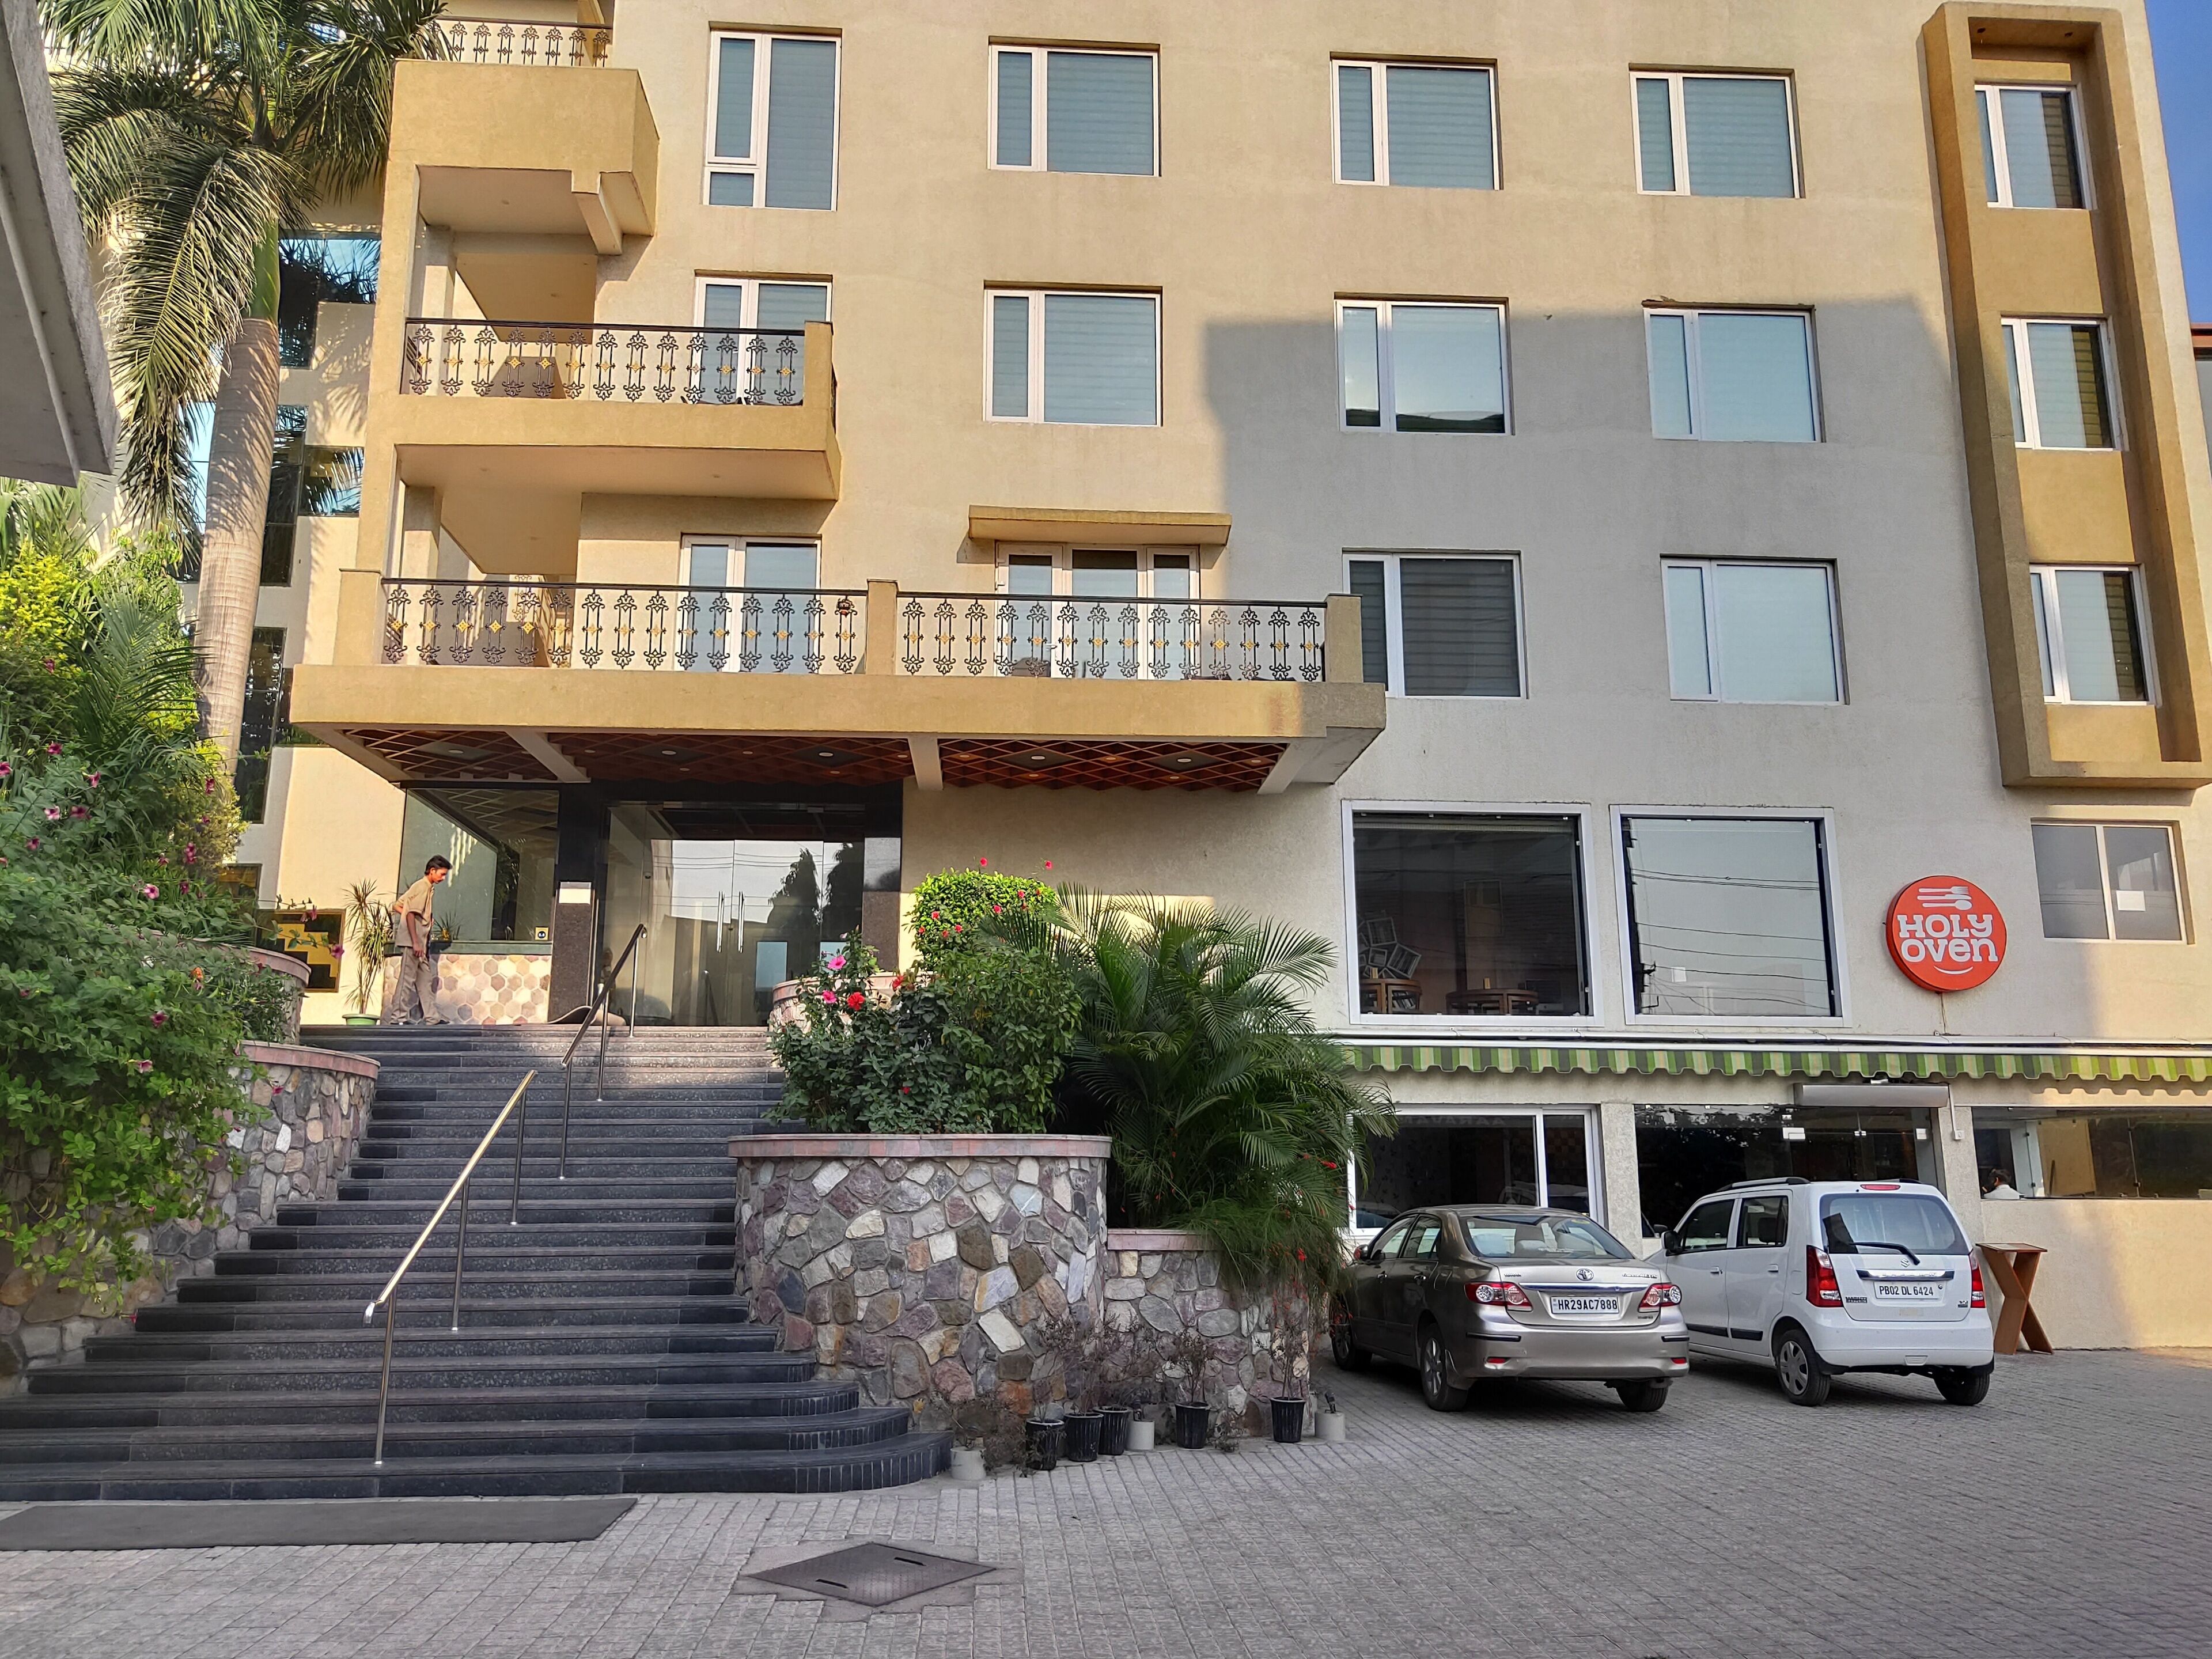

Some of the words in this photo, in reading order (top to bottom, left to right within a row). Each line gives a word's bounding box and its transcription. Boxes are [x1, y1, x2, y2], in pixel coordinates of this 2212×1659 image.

[1897, 914, 1993, 938] HOLY
[1879, 1286, 1900, 1295] PB02
[1901, 1286, 1912, 1295] DL
[1913, 1286, 1934, 1296] 6424
[1558, 1299, 1618, 1310] HR29AC7888
